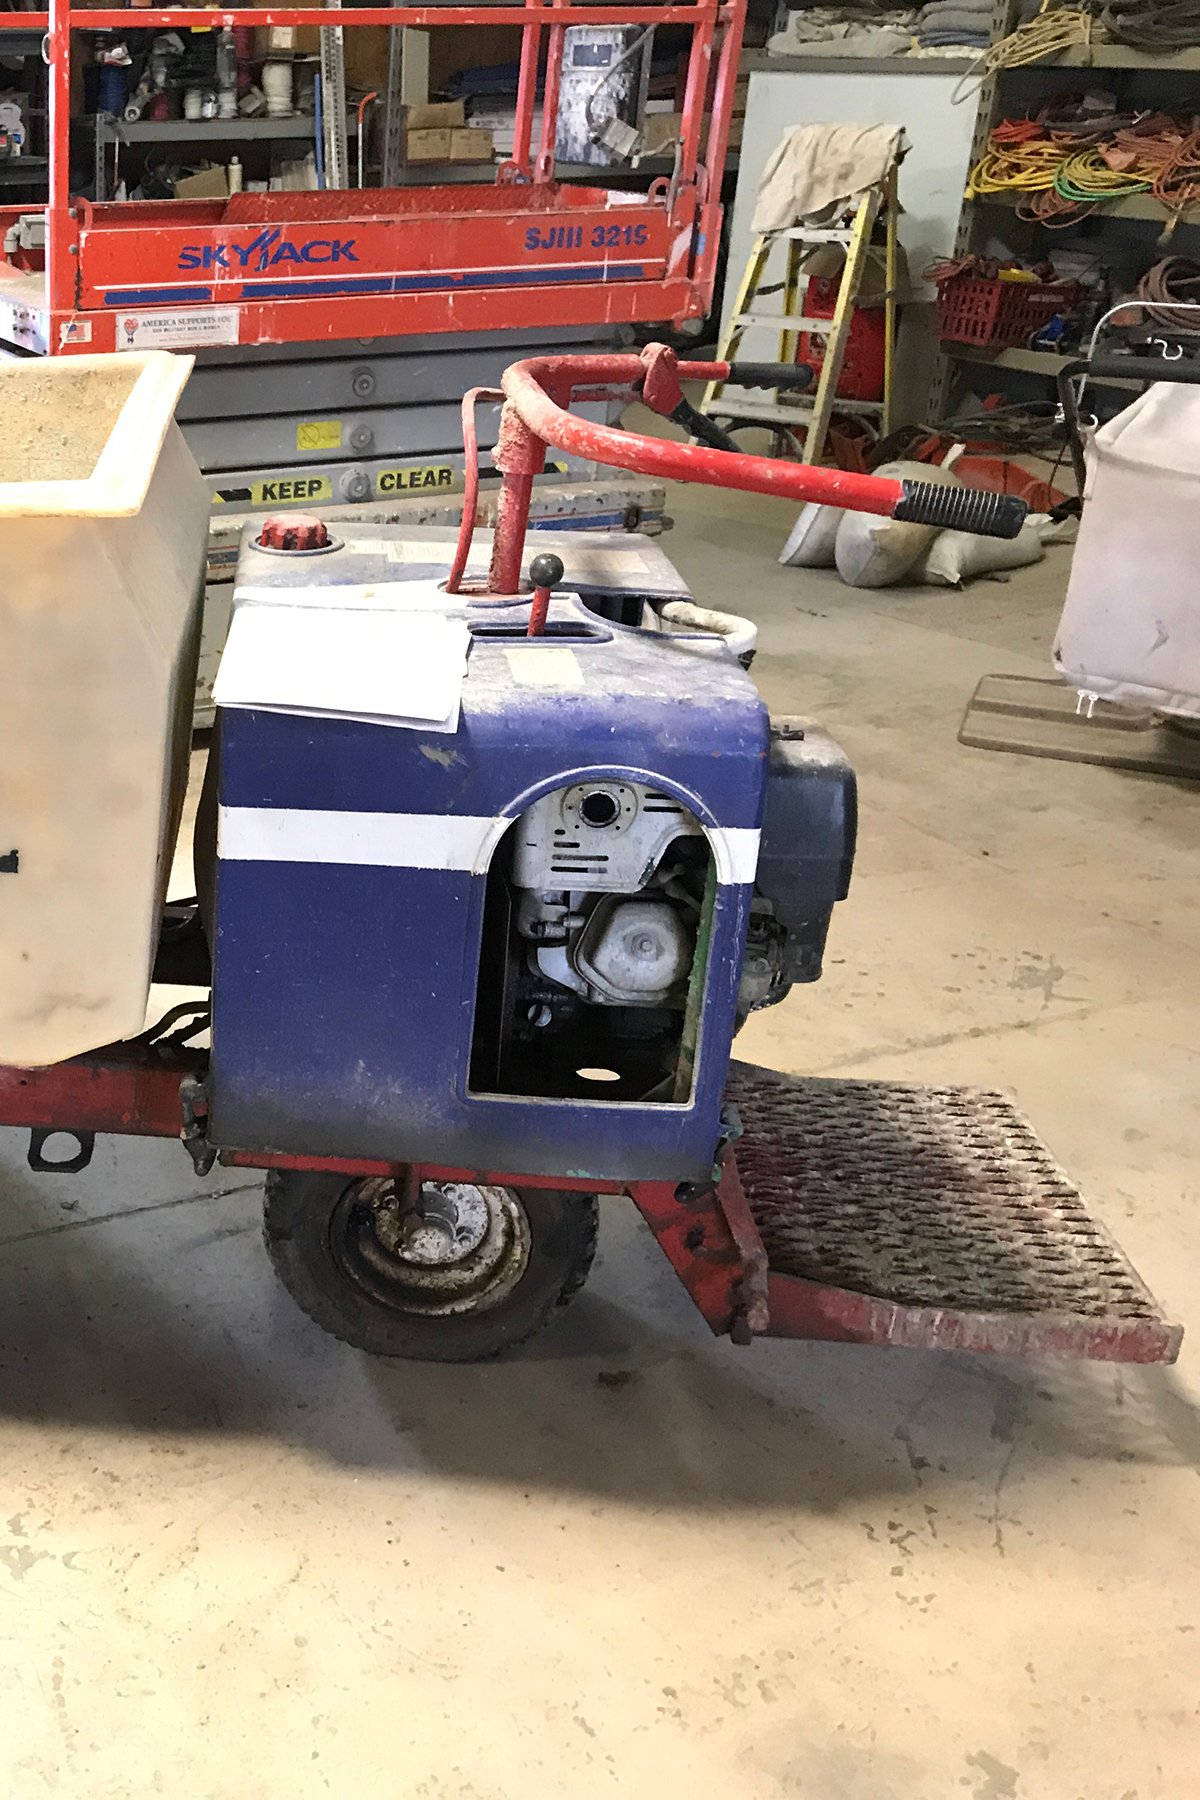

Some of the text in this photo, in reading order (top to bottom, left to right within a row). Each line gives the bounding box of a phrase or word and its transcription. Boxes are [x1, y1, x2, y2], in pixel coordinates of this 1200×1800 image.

[177, 228, 360, 272] SKYJACK
[141, 319, 177, 328] AMERICA
[178, 316, 216, 326] SUPPORTS
[261, 468, 453, 501] KEEP CLEAR
